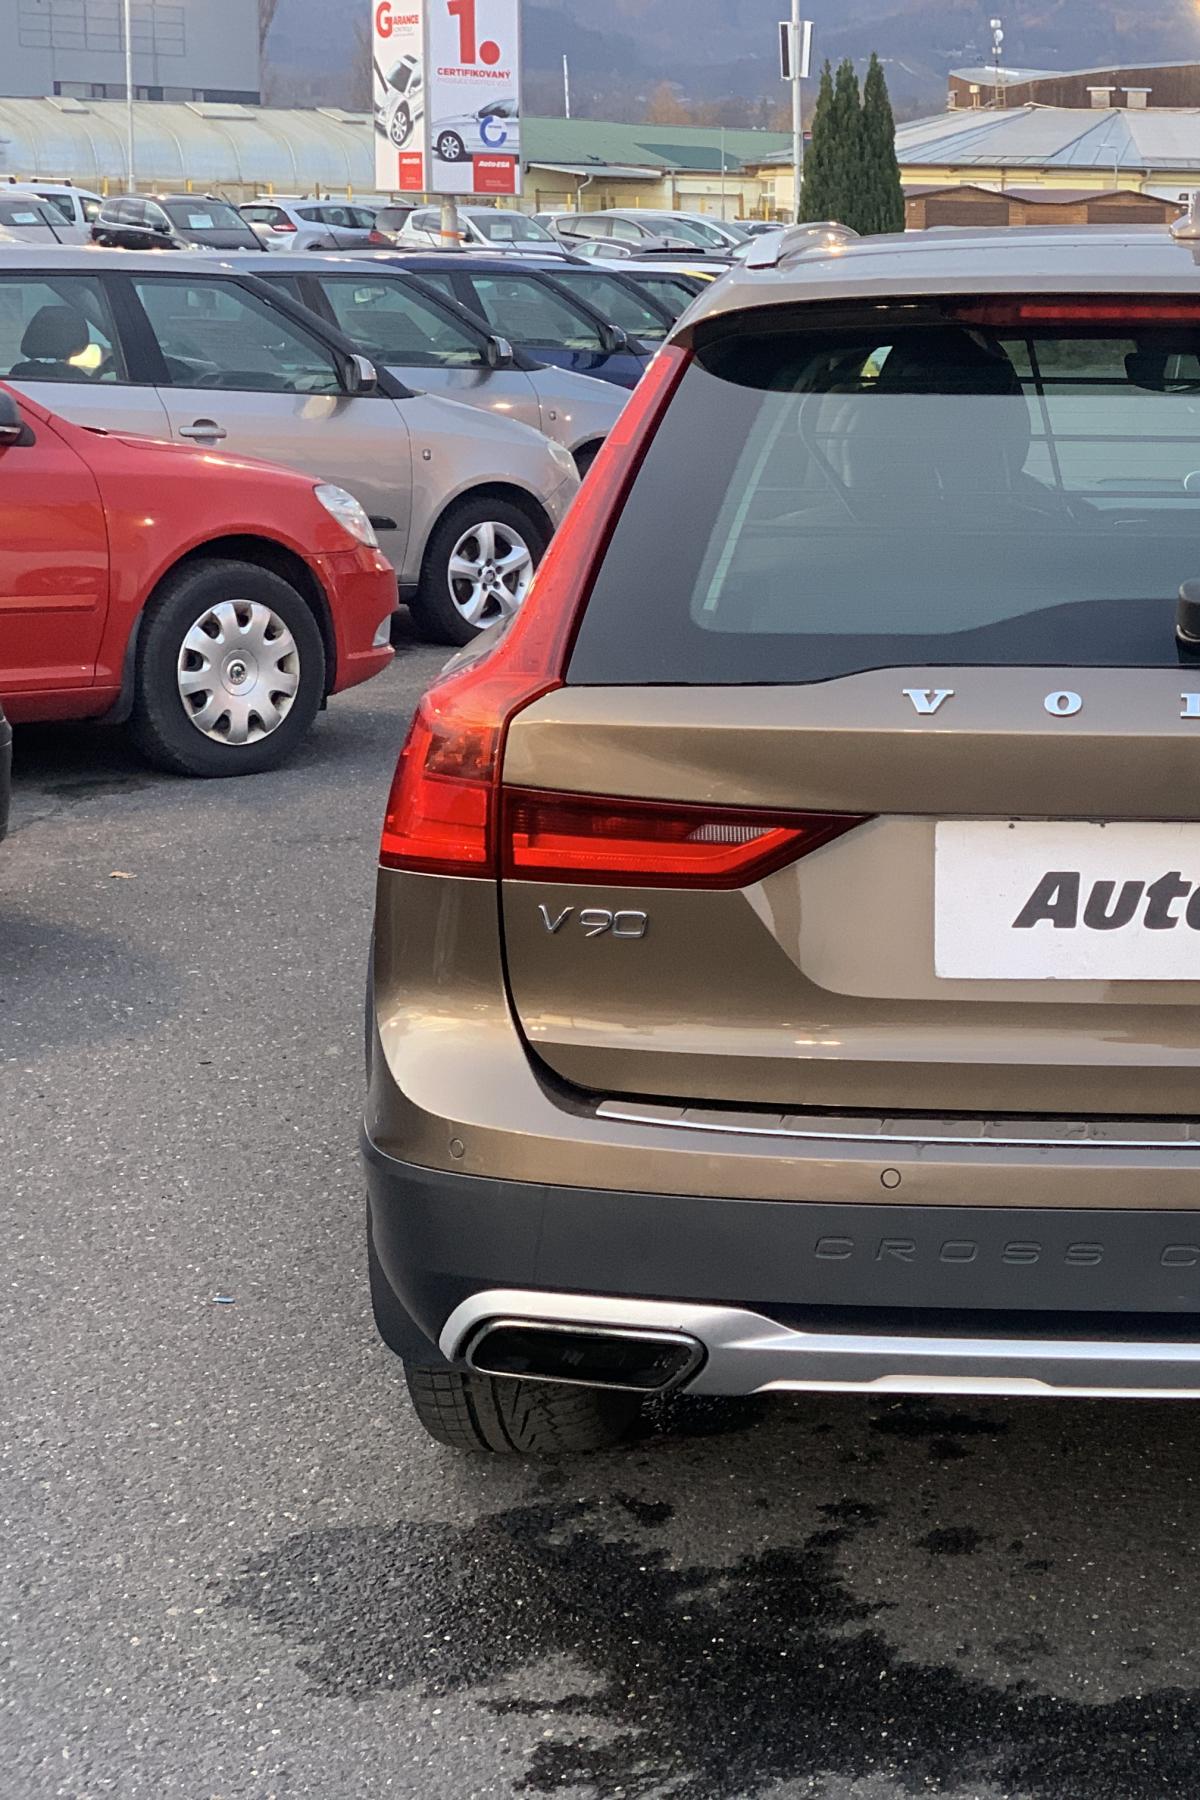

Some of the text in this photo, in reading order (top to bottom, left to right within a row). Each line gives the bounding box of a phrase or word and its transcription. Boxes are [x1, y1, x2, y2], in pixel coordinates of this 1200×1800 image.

[376, 1, 419, 38] GARANCE
[446, 0, 501, 65] 1.
[437, 67, 511, 79] CERTIFIKOVANÝ
[814, 1236, 1104, 1266] CROSS
